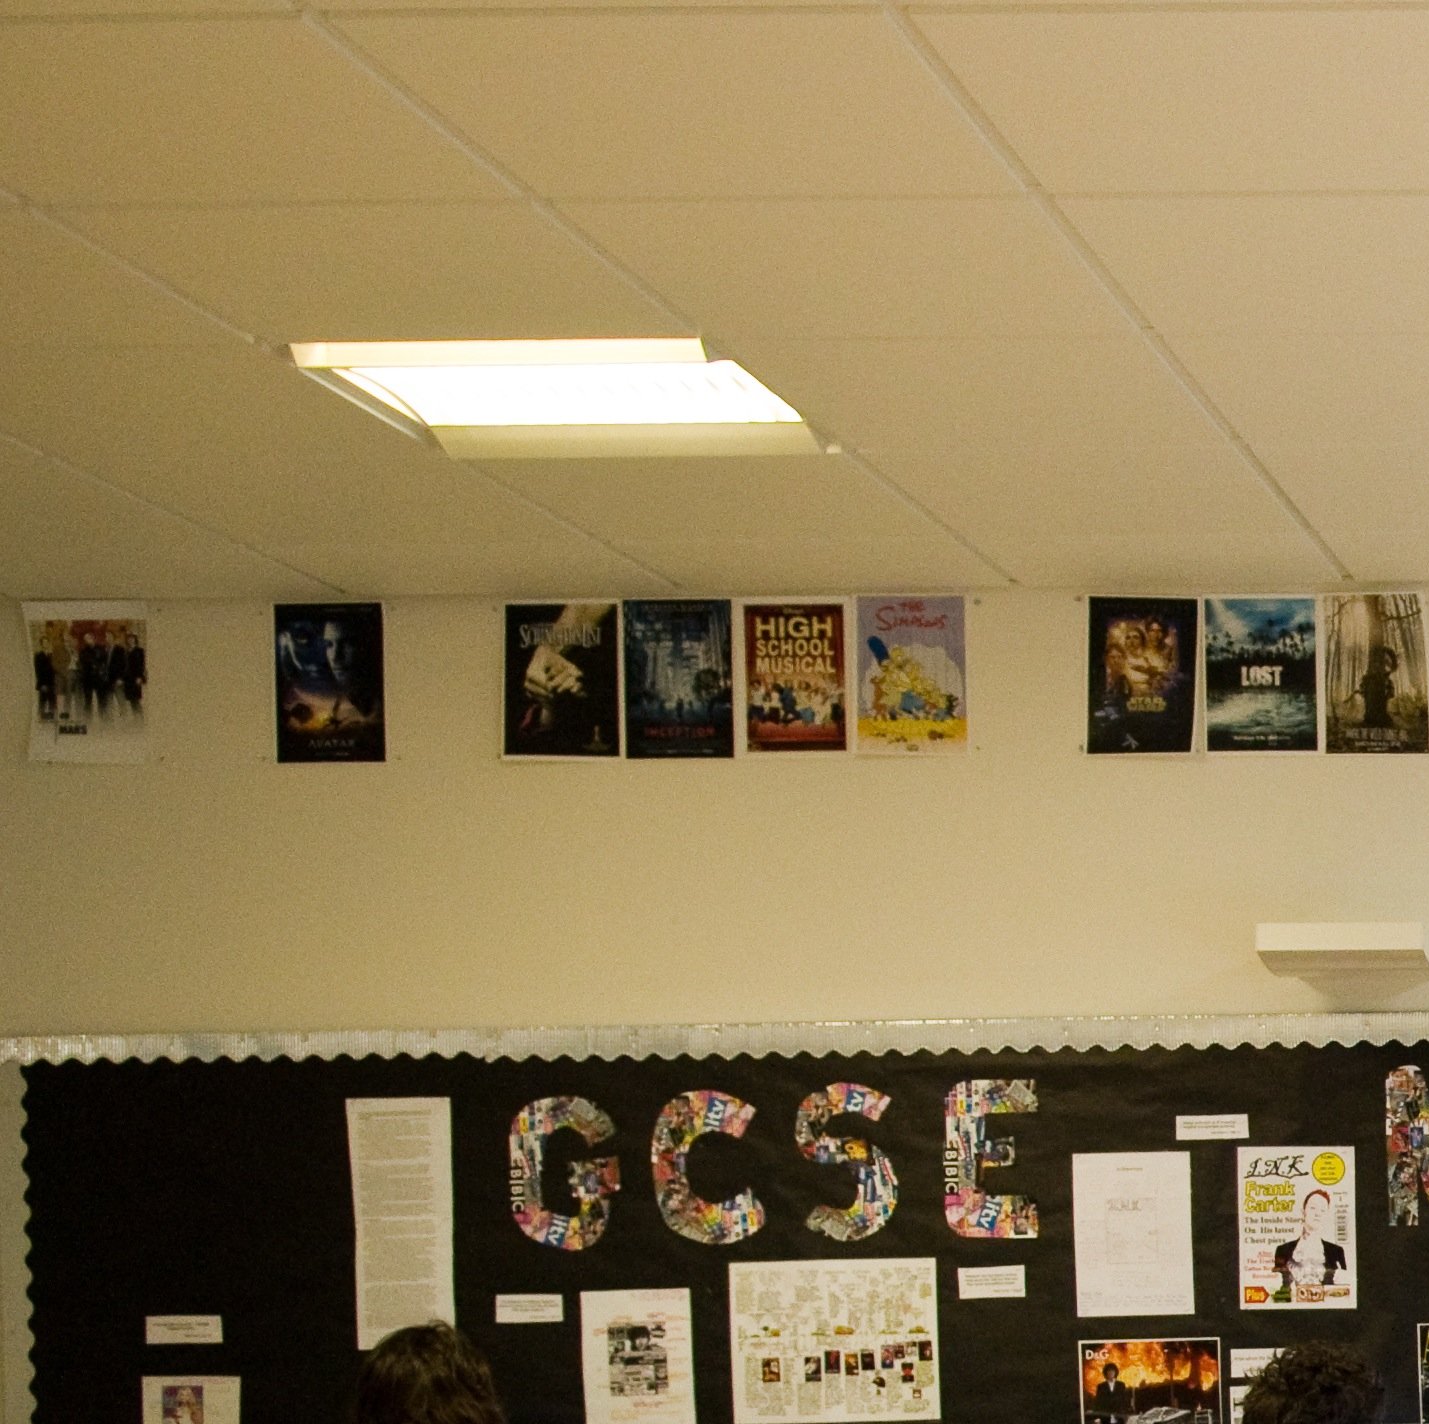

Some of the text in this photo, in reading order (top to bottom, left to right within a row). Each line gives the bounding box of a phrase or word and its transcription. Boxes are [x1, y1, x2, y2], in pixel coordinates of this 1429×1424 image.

[755, 616, 832, 638] HIGH
[757, 640, 834, 656] SCHOOL
[756, 656, 836, 674] MUSICAL
[1241, 666, 1283, 687] LOST
[508, 1079, 1038, 1250] GCSE
[944, 1148, 960, 1194] BBC
[508, 1167, 525, 1213] BBC
[1244, 1181, 1295, 1197] Frank
[1244, 1197, 1295, 1213] Carter
[1085, 1349, 1109, 1361] D&G
